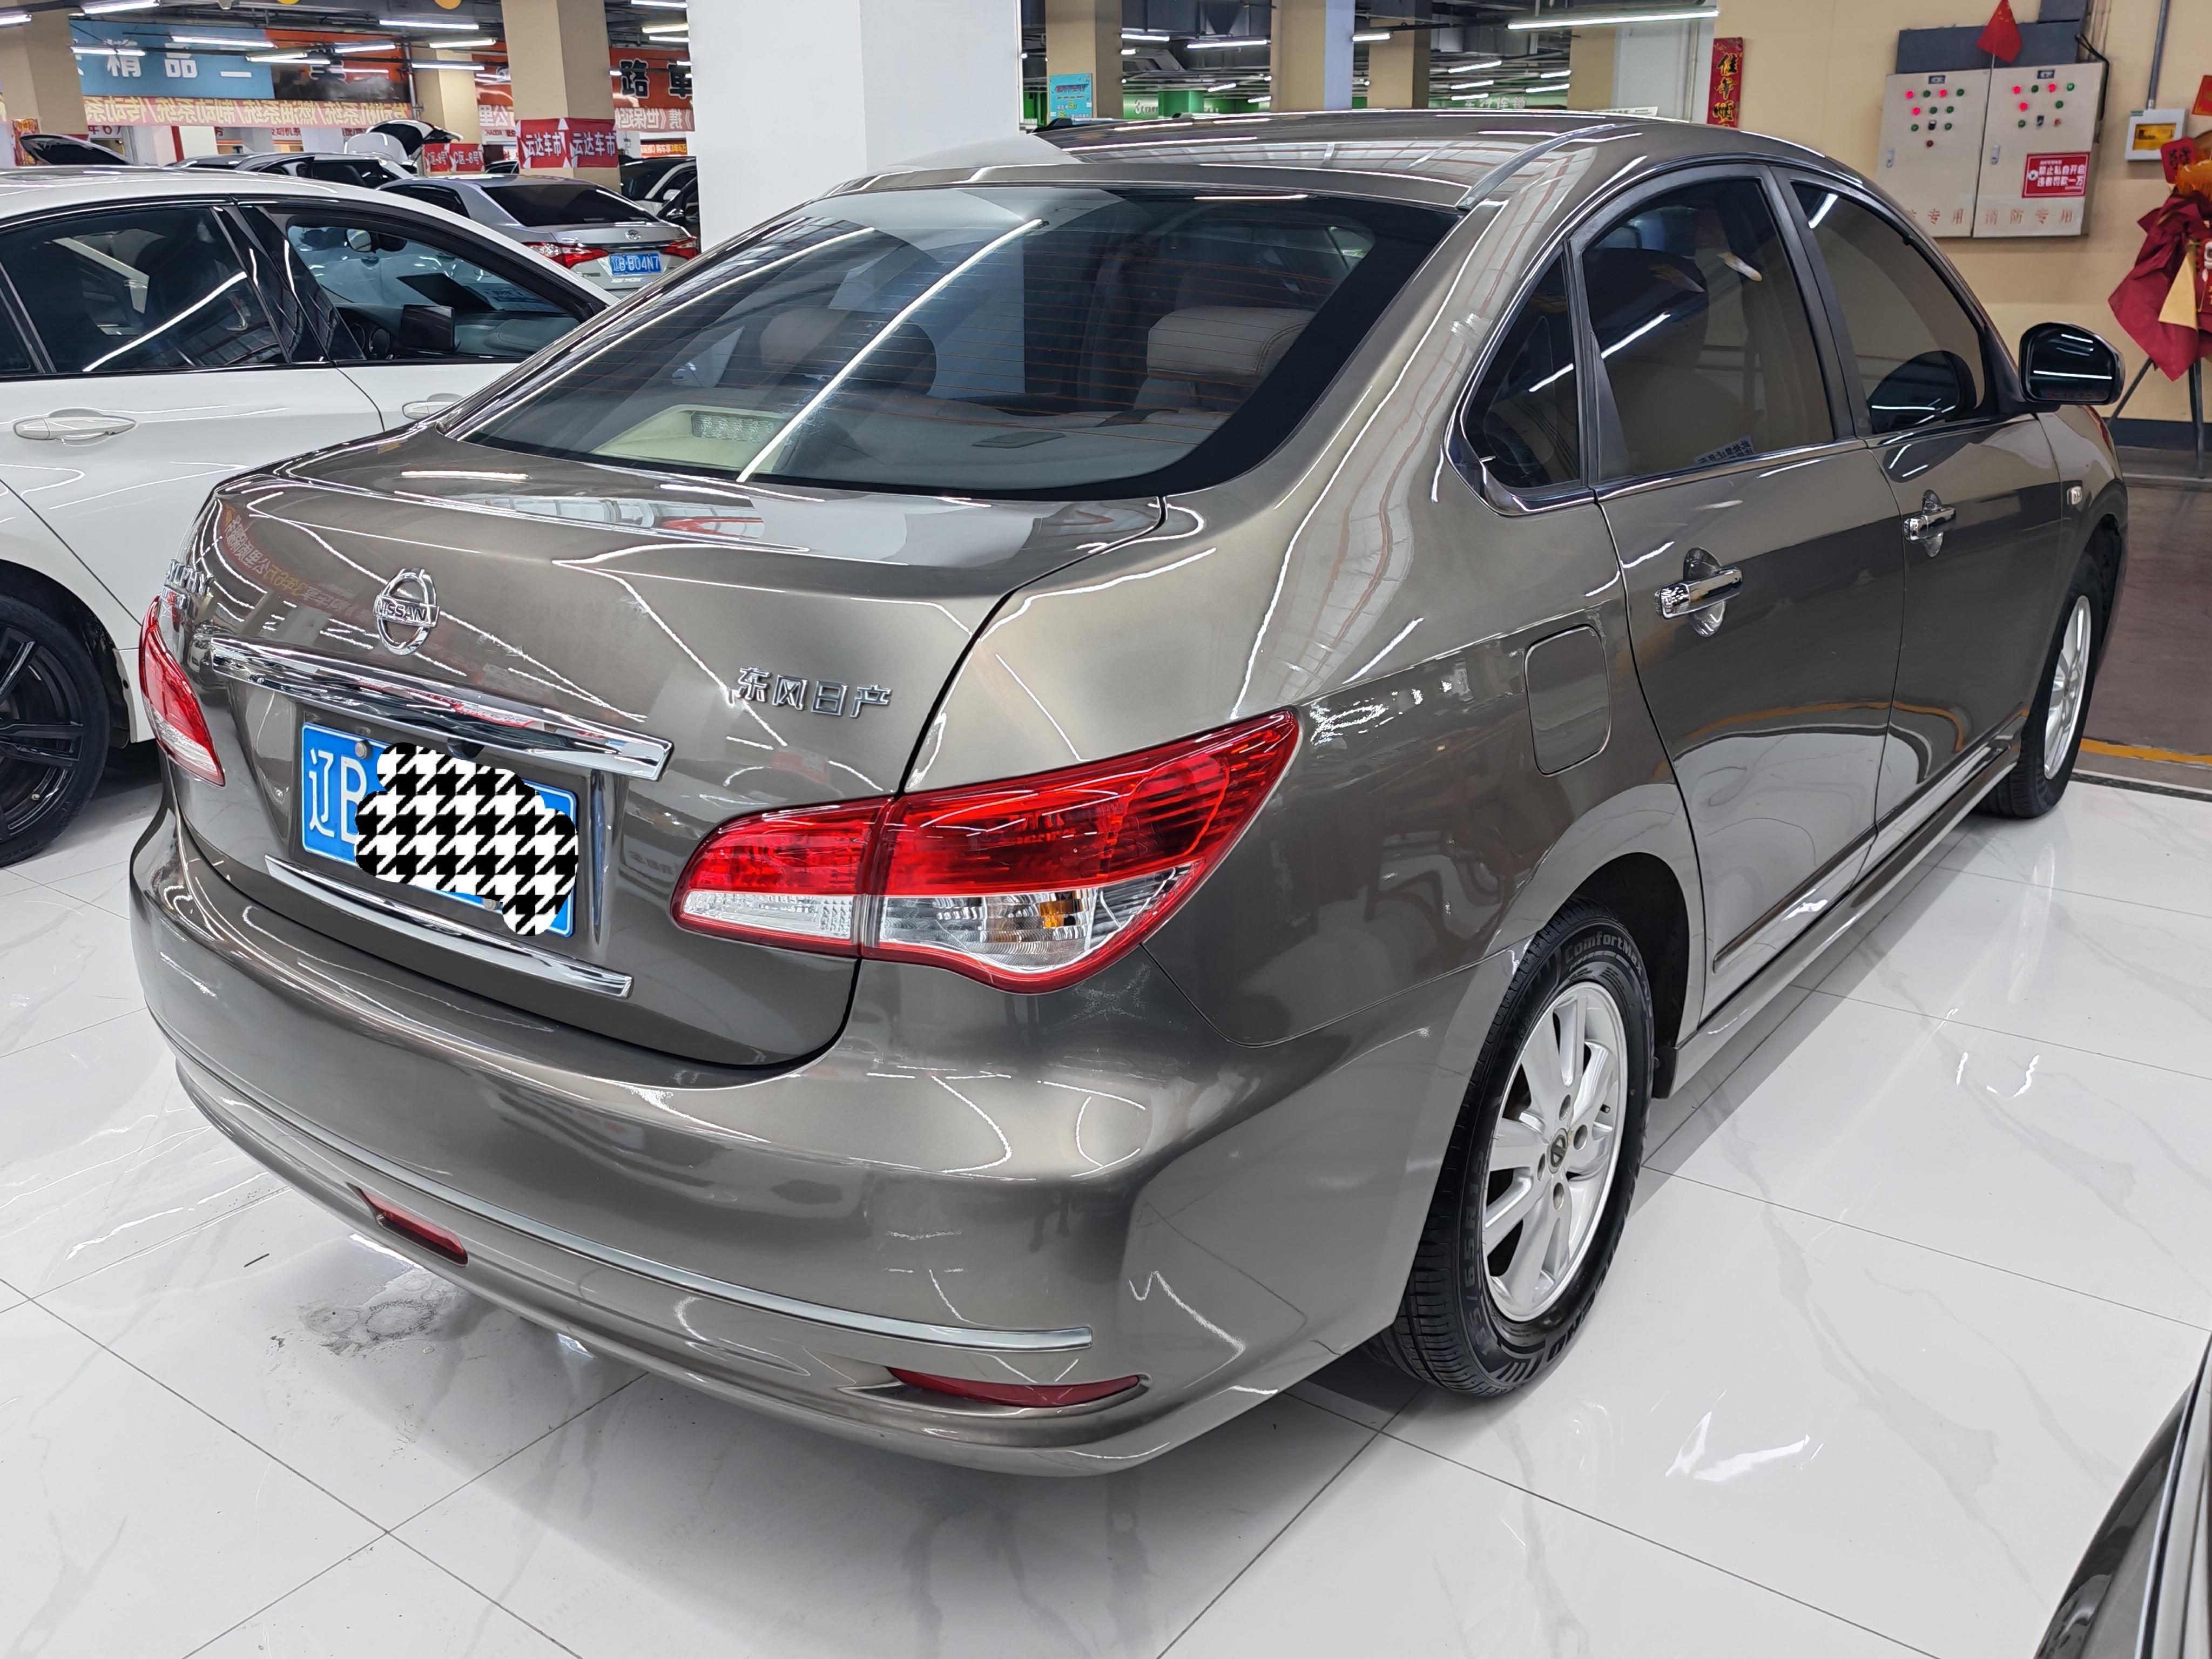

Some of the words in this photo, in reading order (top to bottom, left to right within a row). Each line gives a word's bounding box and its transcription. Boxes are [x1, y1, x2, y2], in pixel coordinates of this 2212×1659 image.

[525, 132, 562, 157] 云达车市
[572, 131, 617, 157] 云达车市
[376, 595, 428, 622] NISSAN
[736, 667, 892, 718] 东风日产
